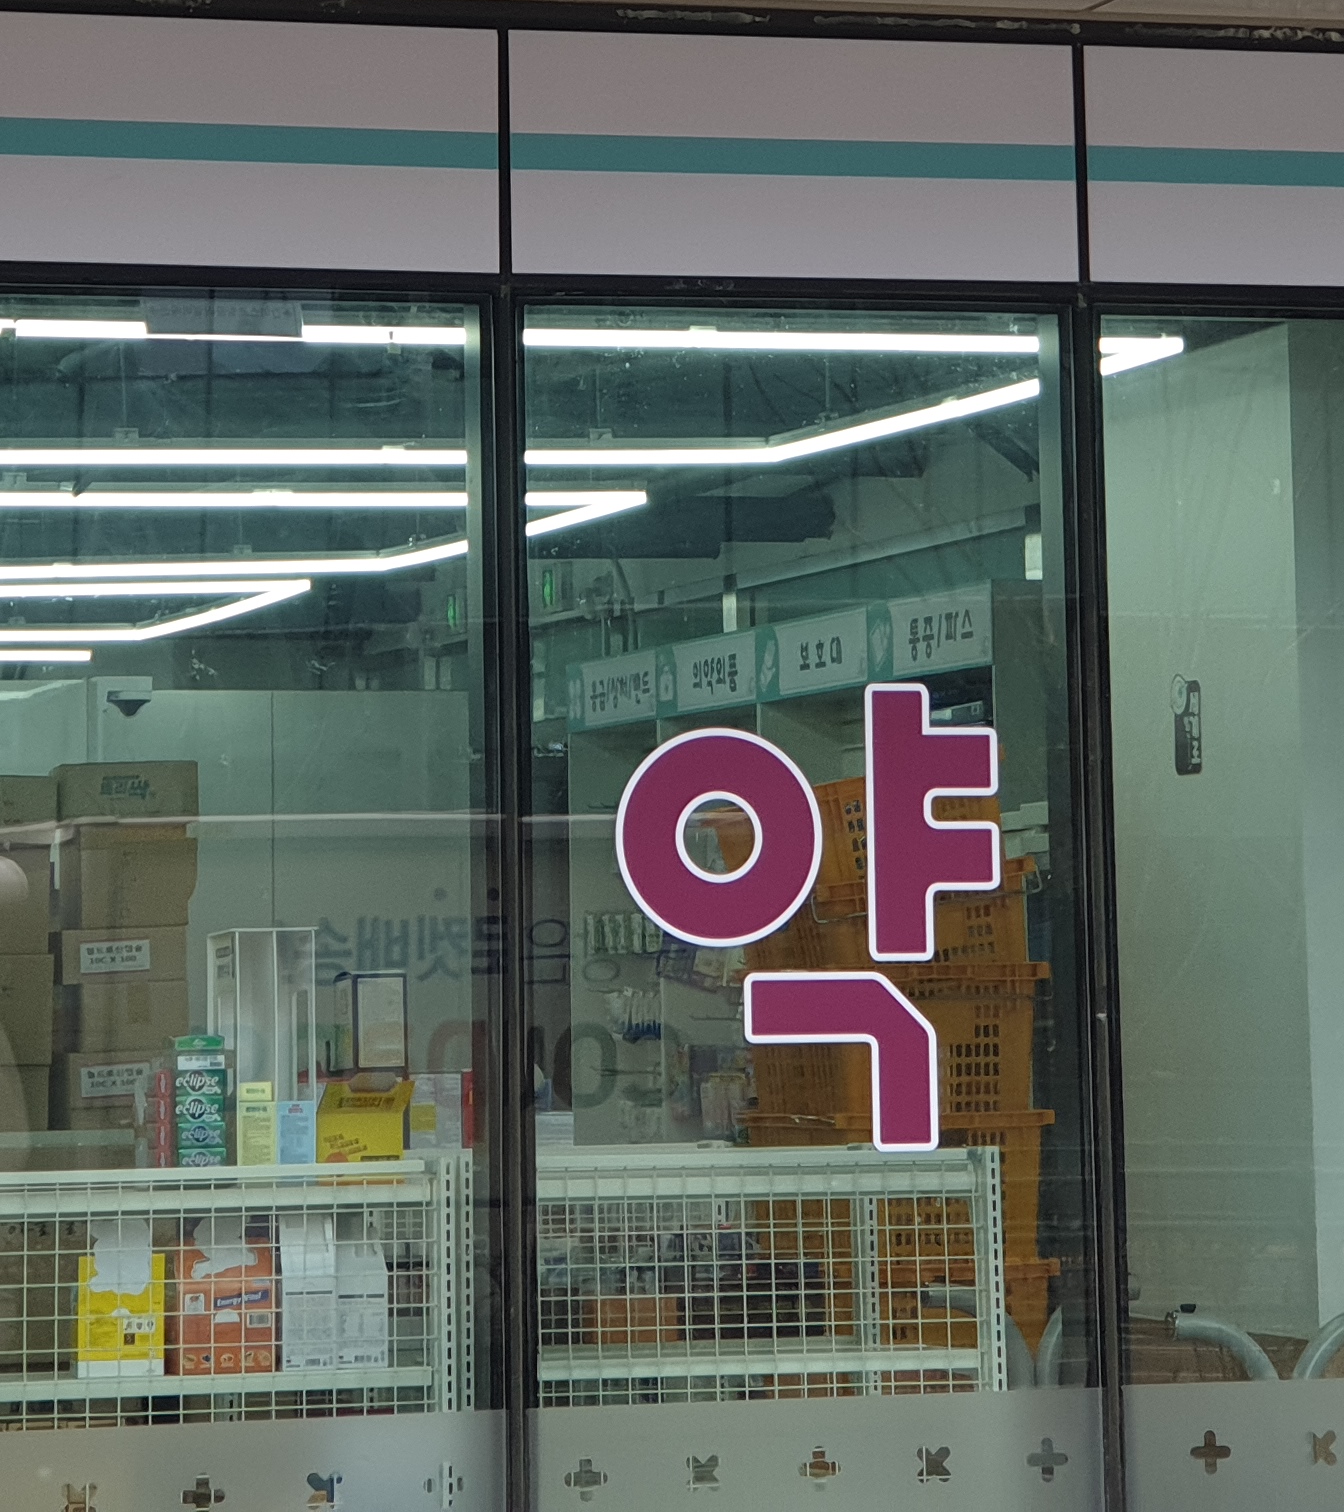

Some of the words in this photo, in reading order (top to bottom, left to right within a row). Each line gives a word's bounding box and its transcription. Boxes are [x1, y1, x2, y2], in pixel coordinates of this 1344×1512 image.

[799, 636, 844, 671] 보호대
[908, 608, 975, 662] 통증/파스
[692, 653, 739, 695] 의약외품
[615, 682, 1001, 1152] 약
[175, 1069, 220, 1088] eclipse
[175, 1097, 218, 1117] eclipse
